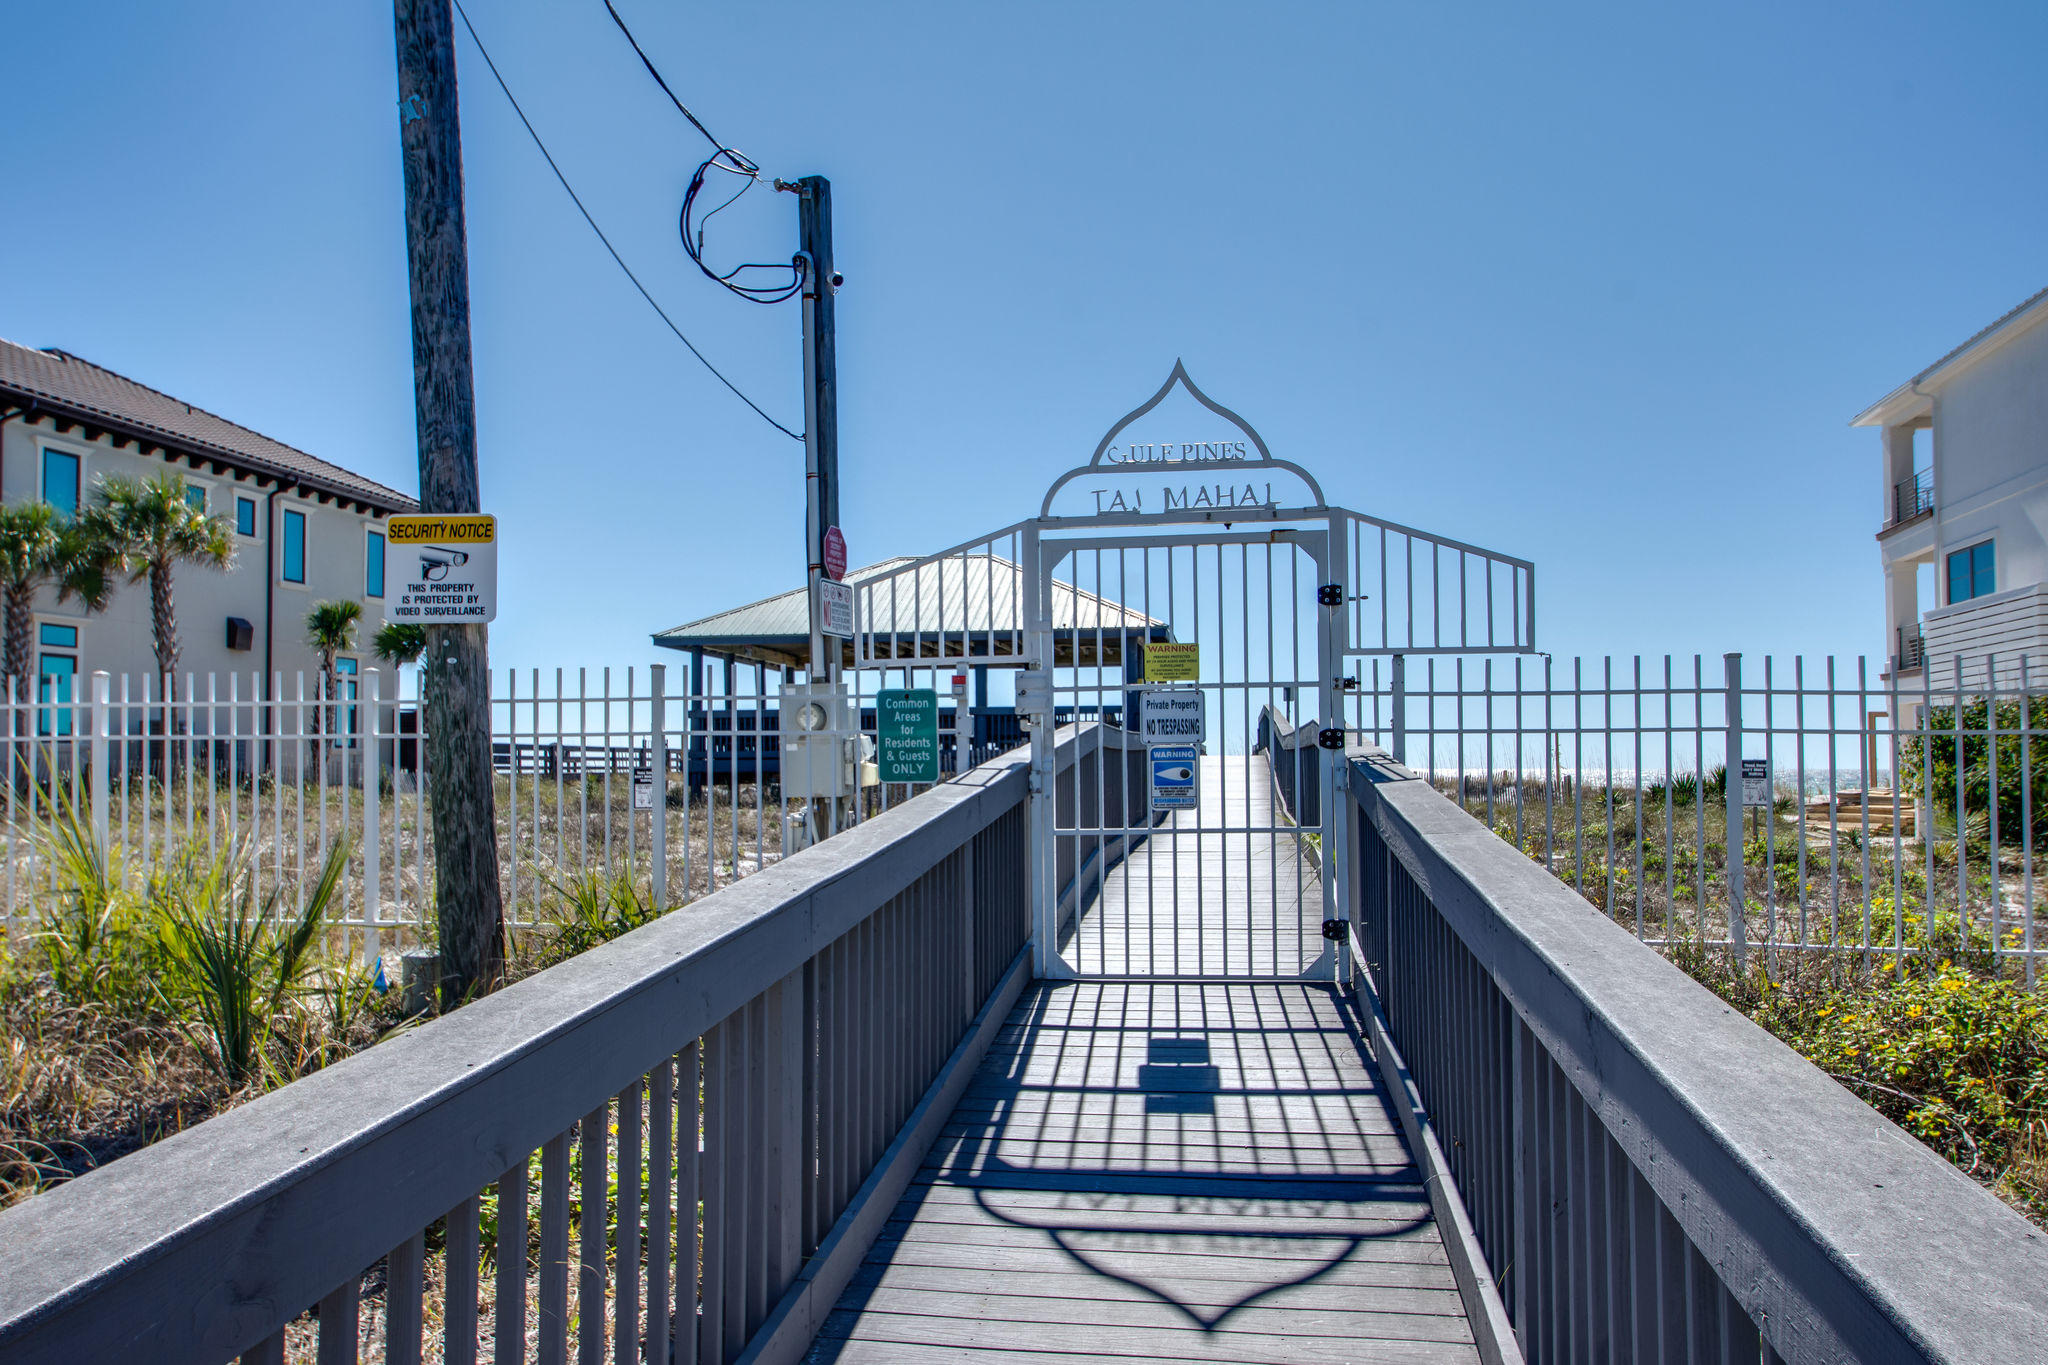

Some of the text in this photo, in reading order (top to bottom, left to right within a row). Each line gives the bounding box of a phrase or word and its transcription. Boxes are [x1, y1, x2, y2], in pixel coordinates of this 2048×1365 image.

[1107, 442, 1246, 464] GULF PINES
[1091, 483, 1281, 512] TAJ MAHAL
[389, 523, 492, 539] SECURITY NOTICE
[407, 583, 474, 593] THIS PROPERTY
[402, 595, 479, 604] IS PROTECTED BY
[395, 606, 486, 616] VIDEO SURVEILLANCE
[1147, 644, 1196, 653] WARNING
[885, 698, 929, 709] Common
[1146, 699, 1199, 712] Private Property
[894, 711, 921, 721] Areas
[900, 724, 914, 735] for
[1146, 718, 1200, 735] NO TRESPASSING
[885, 737, 931, 748] Residents
[886, 750, 930, 761] & Guests
[892, 763, 924, 774] ONLY
